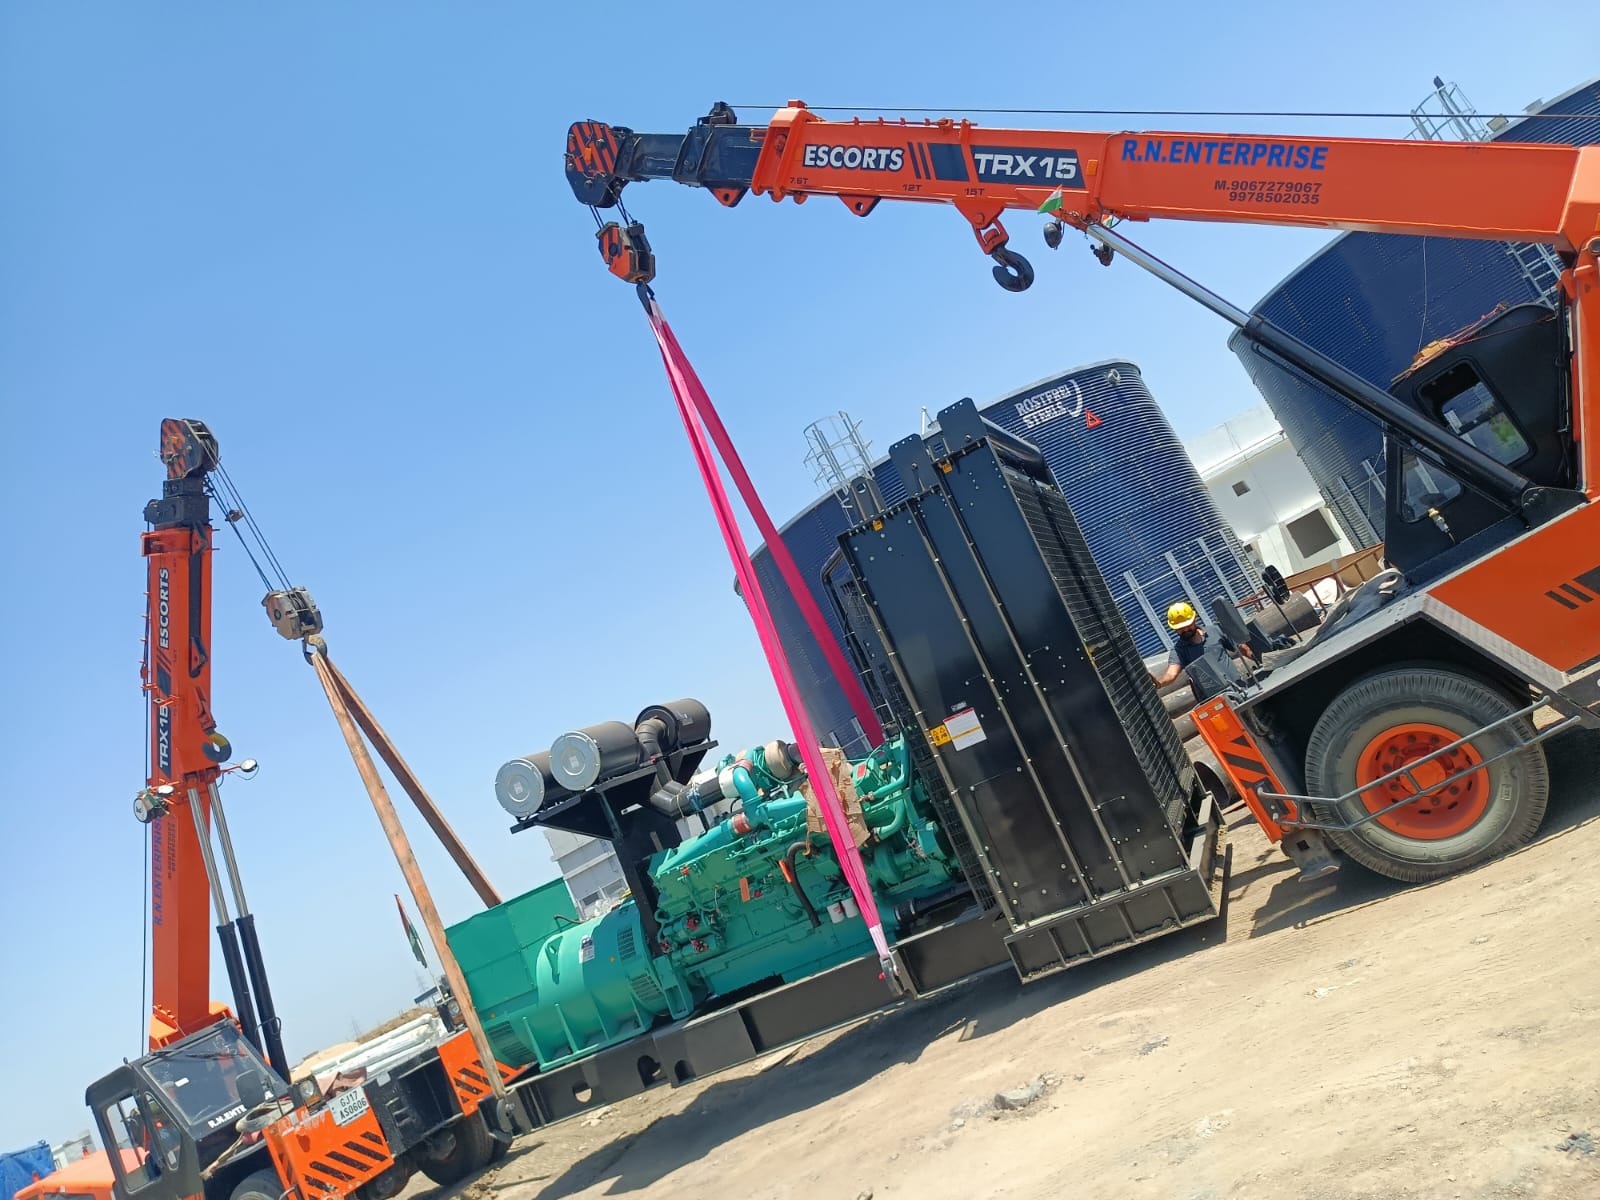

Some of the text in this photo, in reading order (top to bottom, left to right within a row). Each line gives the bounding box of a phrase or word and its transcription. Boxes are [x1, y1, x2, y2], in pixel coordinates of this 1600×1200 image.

[803, 144, 905, 172] ESCORTS
[1121, 139, 1328, 170] R.N.ENTERPRISE
[965, 187, 984, 195] 15T
[1229, 191, 1320, 204] 9978502035
[160, 568, 169, 649] ESCORTS
[339, 1097, 368, 1120] AS0606
[340, 1090, 359, 1109] GJ17
